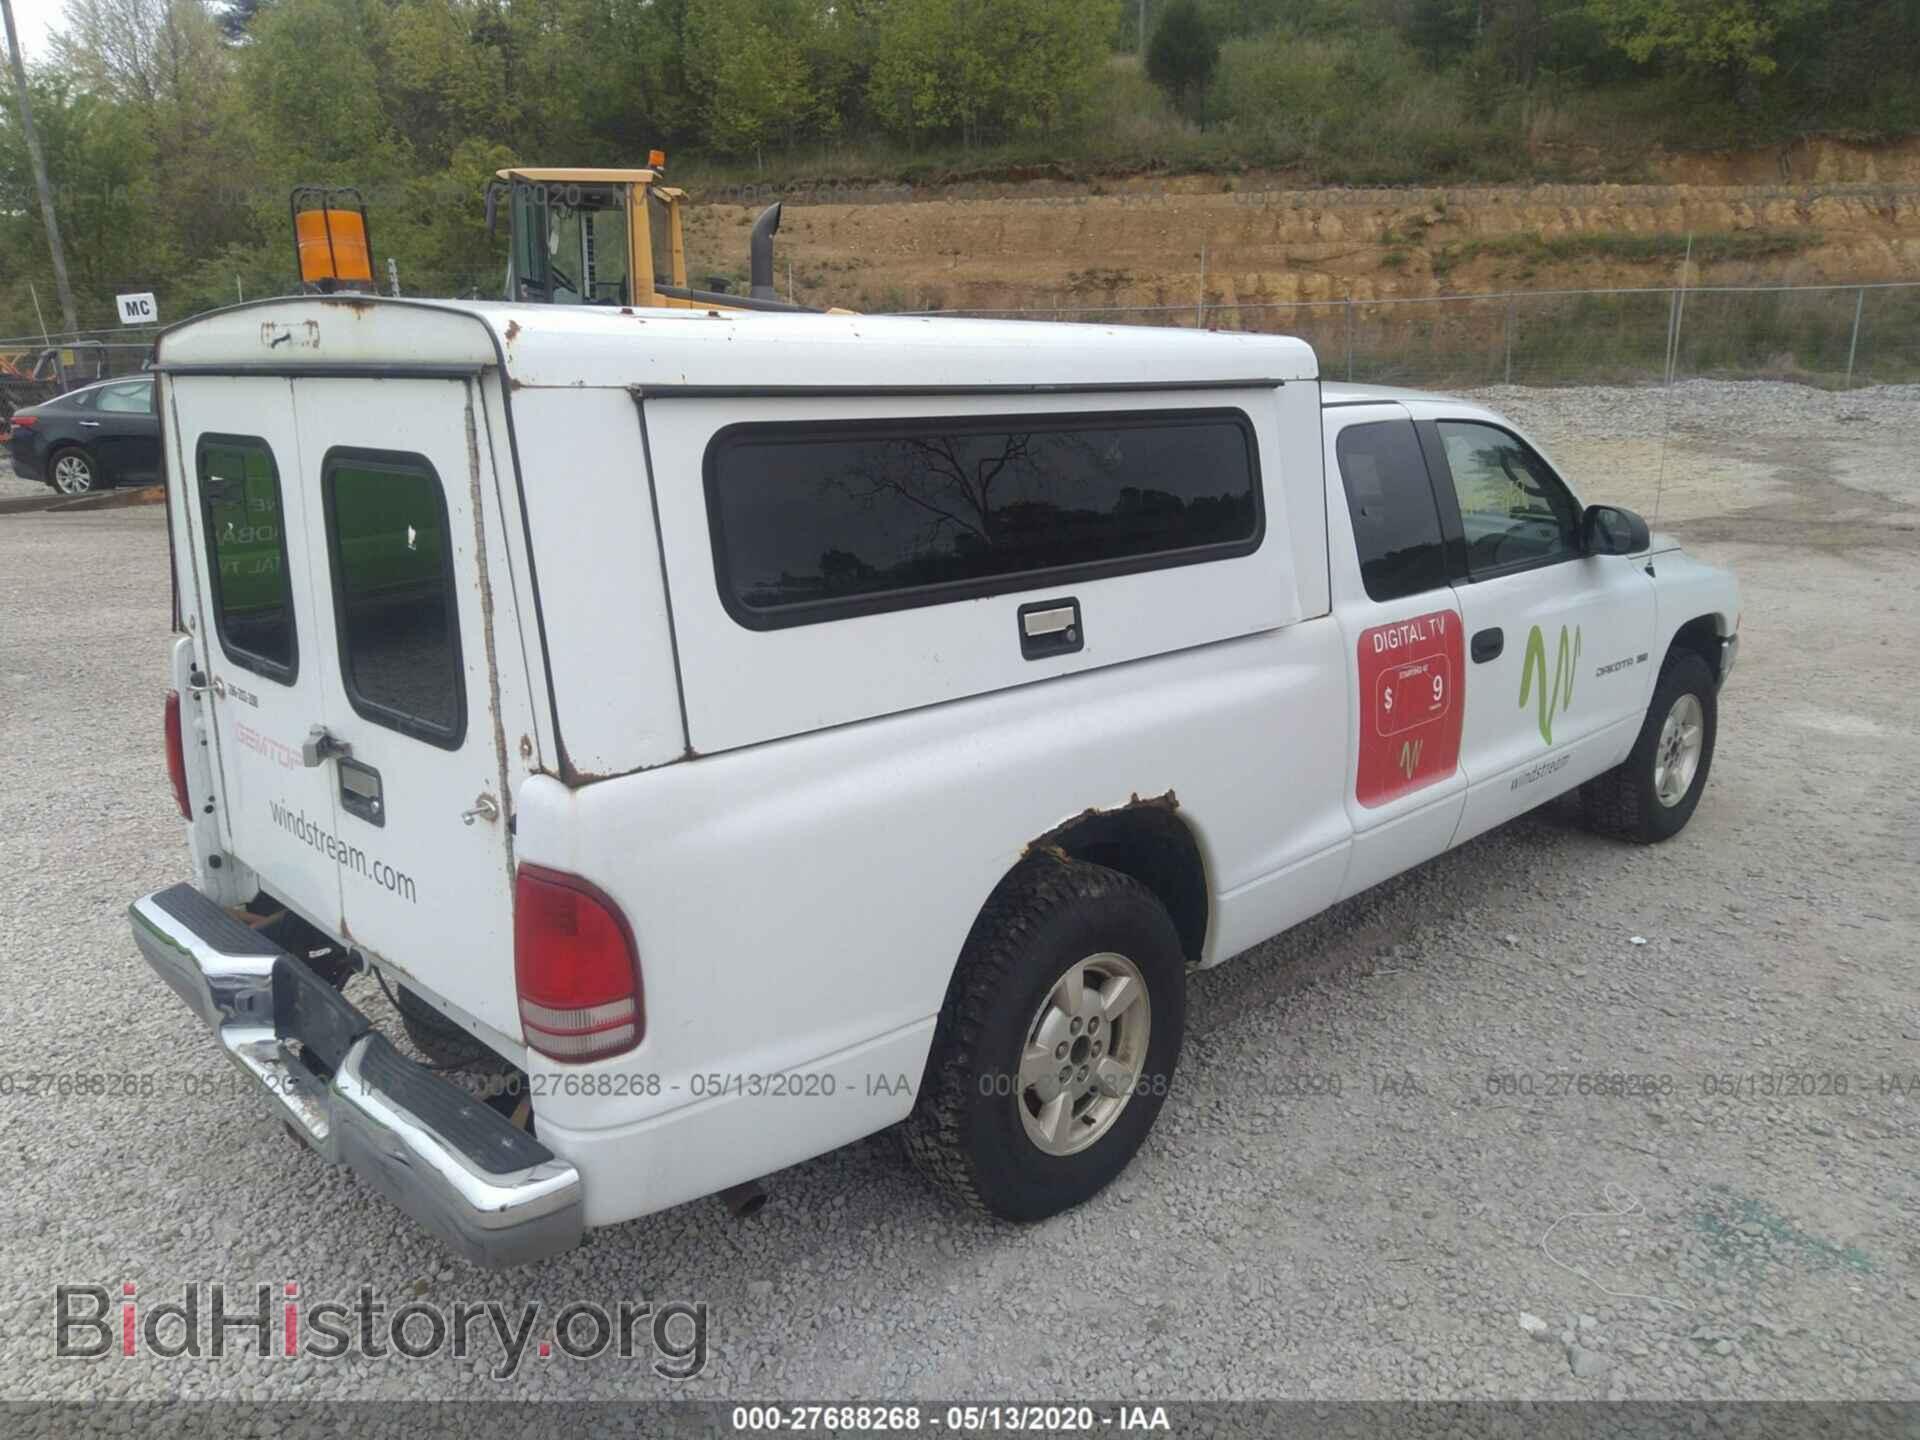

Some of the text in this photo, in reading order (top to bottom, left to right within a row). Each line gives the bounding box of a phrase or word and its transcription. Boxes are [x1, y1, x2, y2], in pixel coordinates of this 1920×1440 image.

[125, 300, 151, 316] MC
[1373, 615, 1445, 653] DIGITAL TV
[1384, 674, 1443, 713] $ 9
[1509, 753, 1571, 792] wdstream
[269, 797, 417, 904] windstream.com
